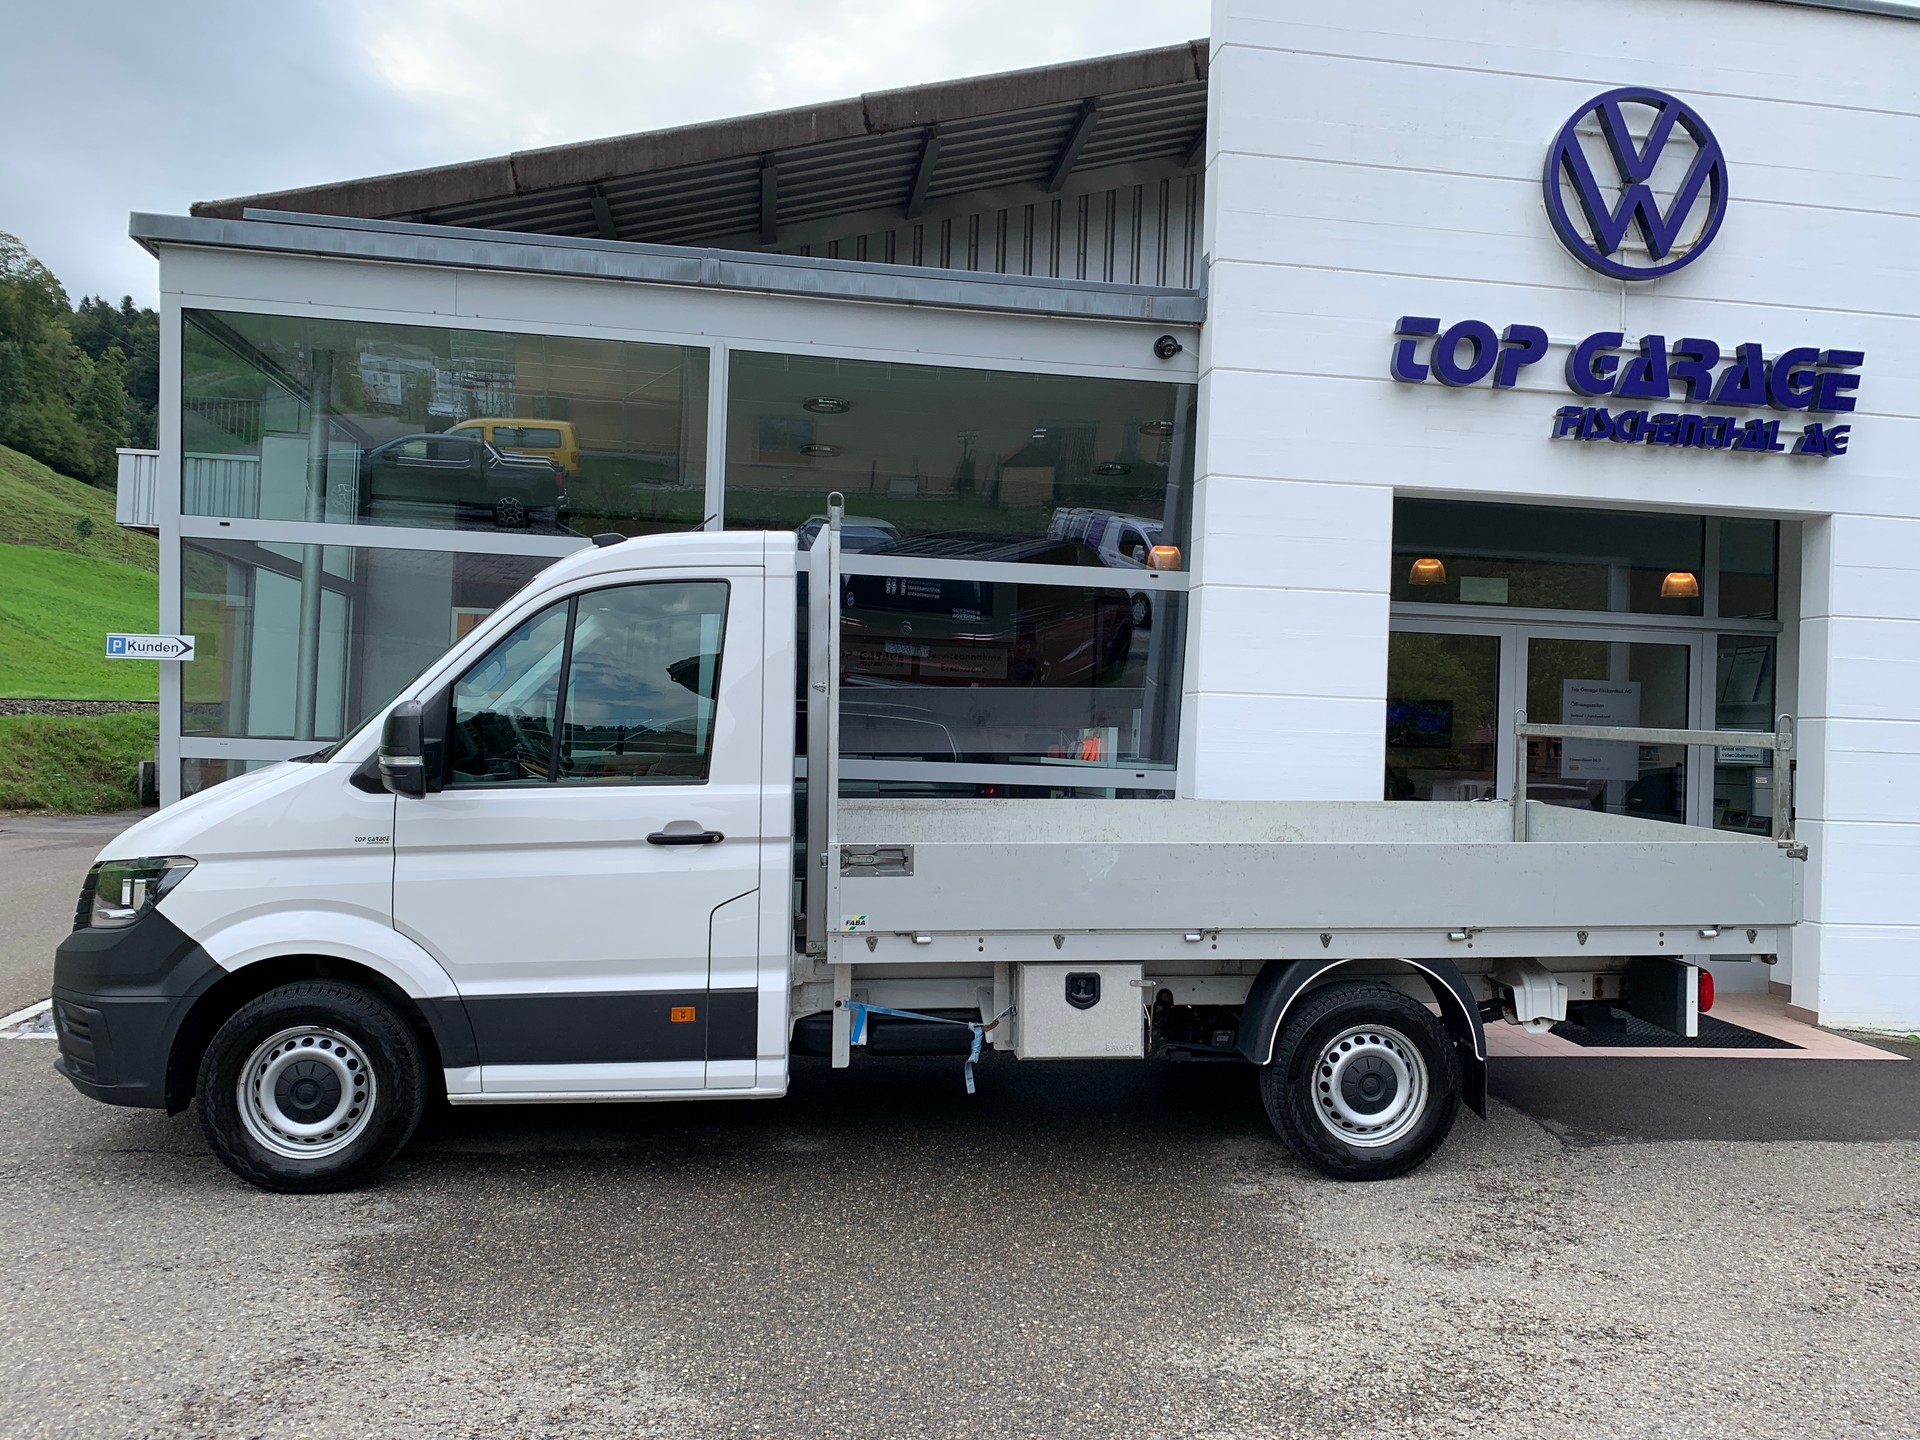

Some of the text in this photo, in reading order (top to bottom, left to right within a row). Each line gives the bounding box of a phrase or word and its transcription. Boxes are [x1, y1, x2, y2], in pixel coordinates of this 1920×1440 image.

[1391, 316, 1865, 412] TOP GARAGE
[1552, 405, 1851, 457] FISCHENTHAL AG
[112, 640, 179, 653] P Kunden
